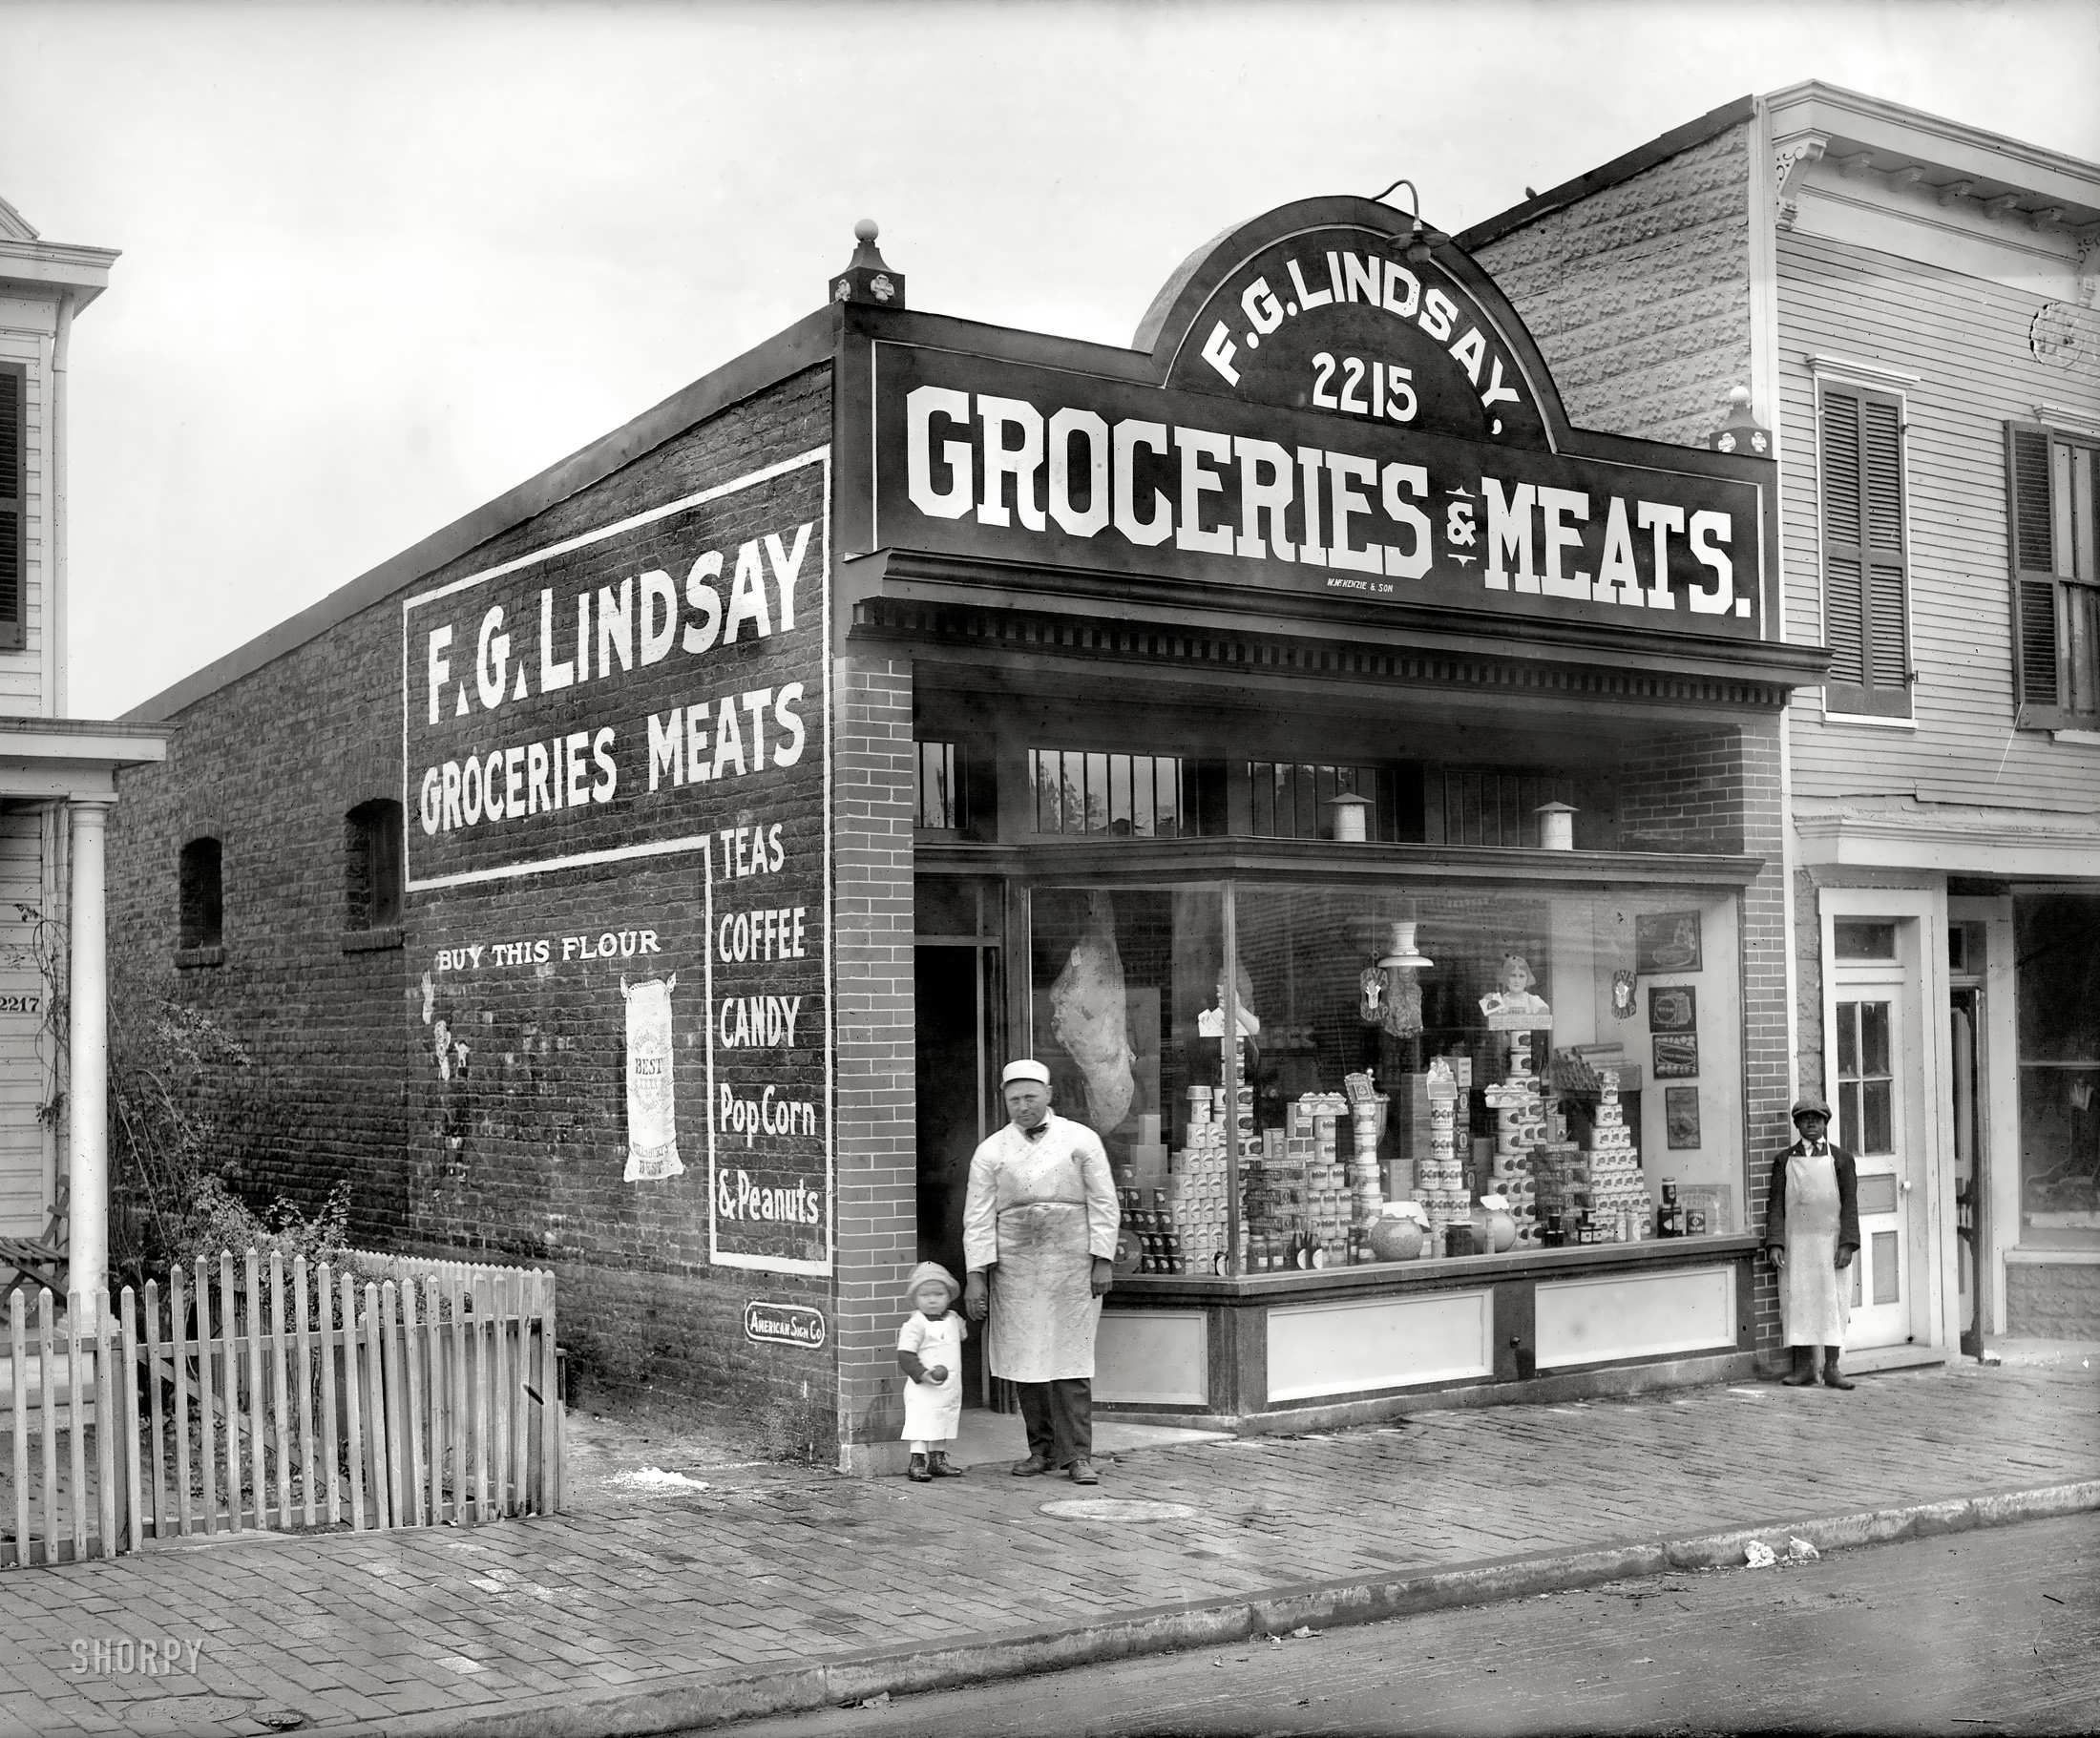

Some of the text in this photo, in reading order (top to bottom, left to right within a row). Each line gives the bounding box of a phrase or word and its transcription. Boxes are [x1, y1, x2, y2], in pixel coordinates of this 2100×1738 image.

[1312, 351, 1418, 422] 2215
[906, 385, 1751, 618] GROCERIES & MEATS.
[539, 521, 814, 694] LINDSAY
[1378, 583, 1394, 593] SON
[420, 681, 806, 836] GROCERIES MEATS
[720, 823, 786, 879] TEAS
[436, 929, 662, 972] BUY THIS FLOUR
[719, 906, 806, 964] COFFEE
[0, 995, 40, 1013] 2217
[719, 995, 803, 1049] CANDY
[635, 1057, 662, 1075] BEST
